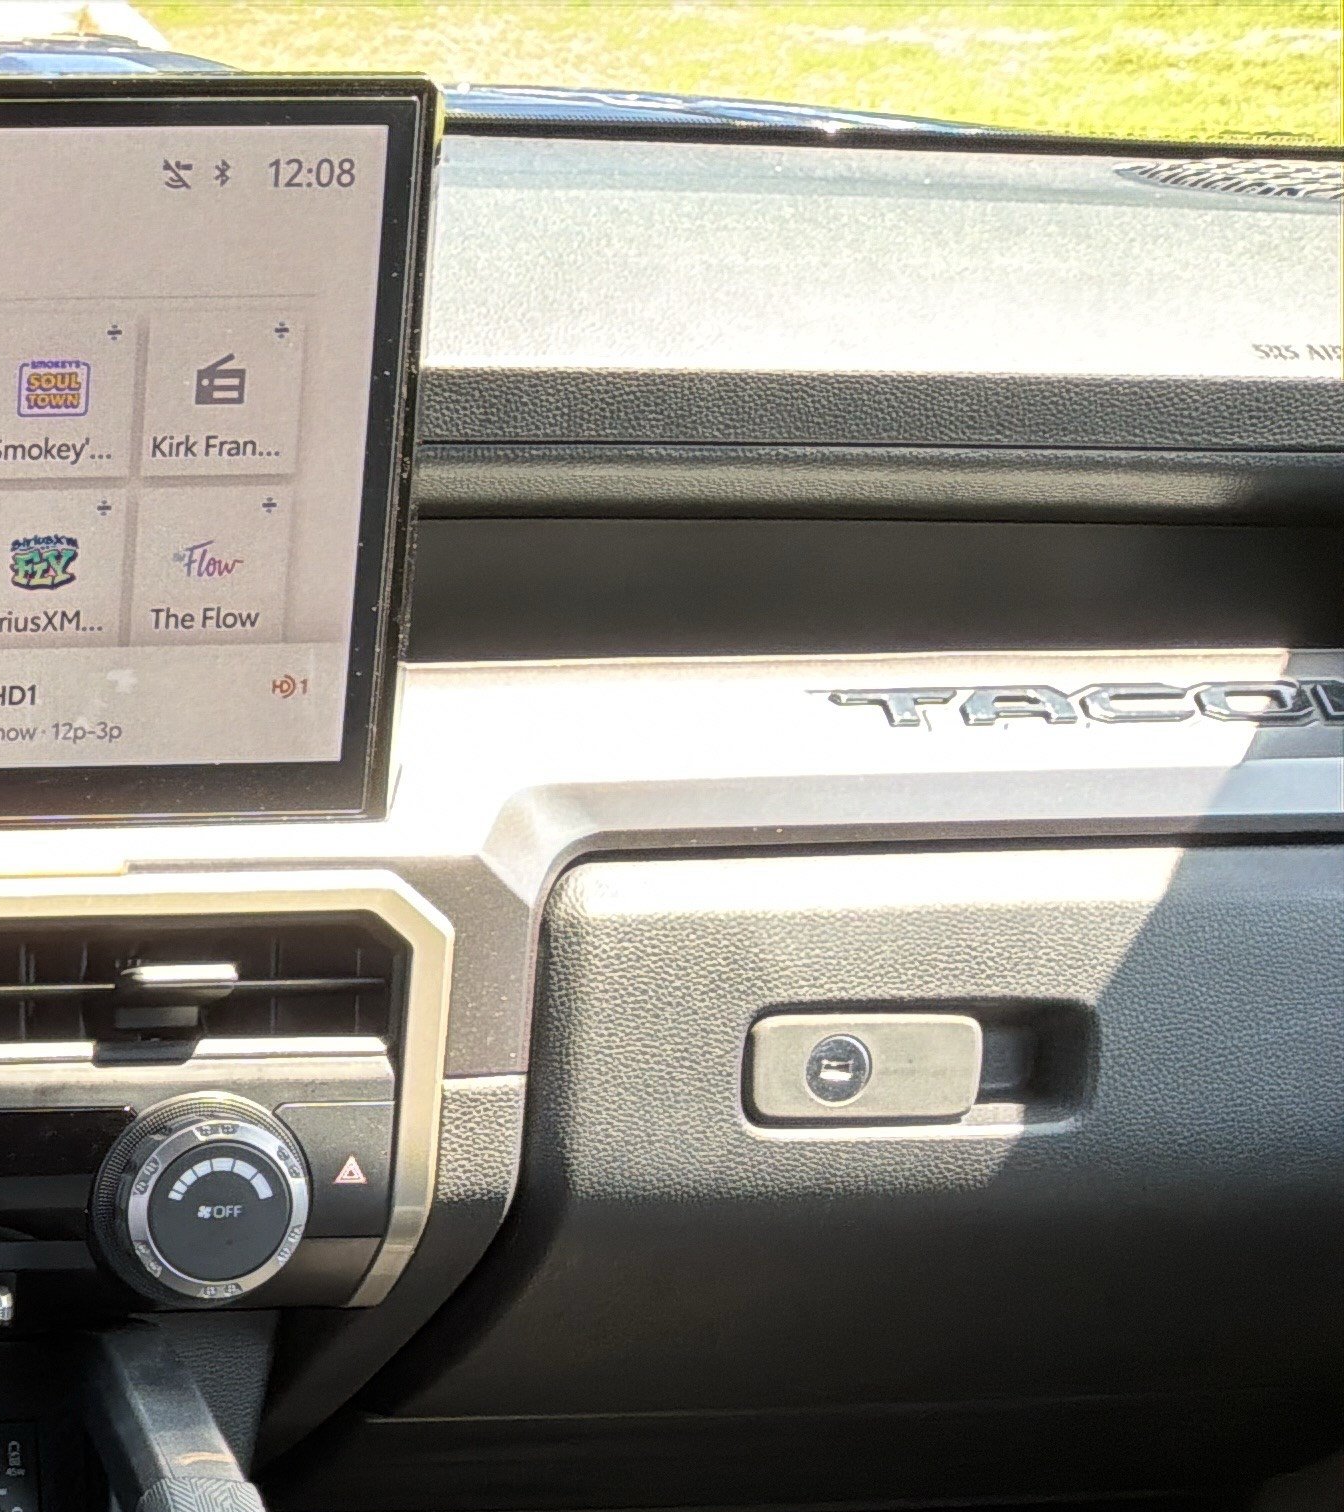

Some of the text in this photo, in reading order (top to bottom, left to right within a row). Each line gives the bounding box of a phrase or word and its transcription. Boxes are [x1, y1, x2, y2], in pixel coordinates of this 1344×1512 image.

[267, 157, 357, 189] 12:08
[26, 371, 82, 391] SOUL
[26, 393, 81, 410] TOWN
[151, 435, 197, 459] Kirk
[183, 539, 245, 578] Flow
[150, 605, 260, 631] The Flow
[51, 720, 123, 744] 12p-3p
[211, 1204, 243, 1219] OFF
